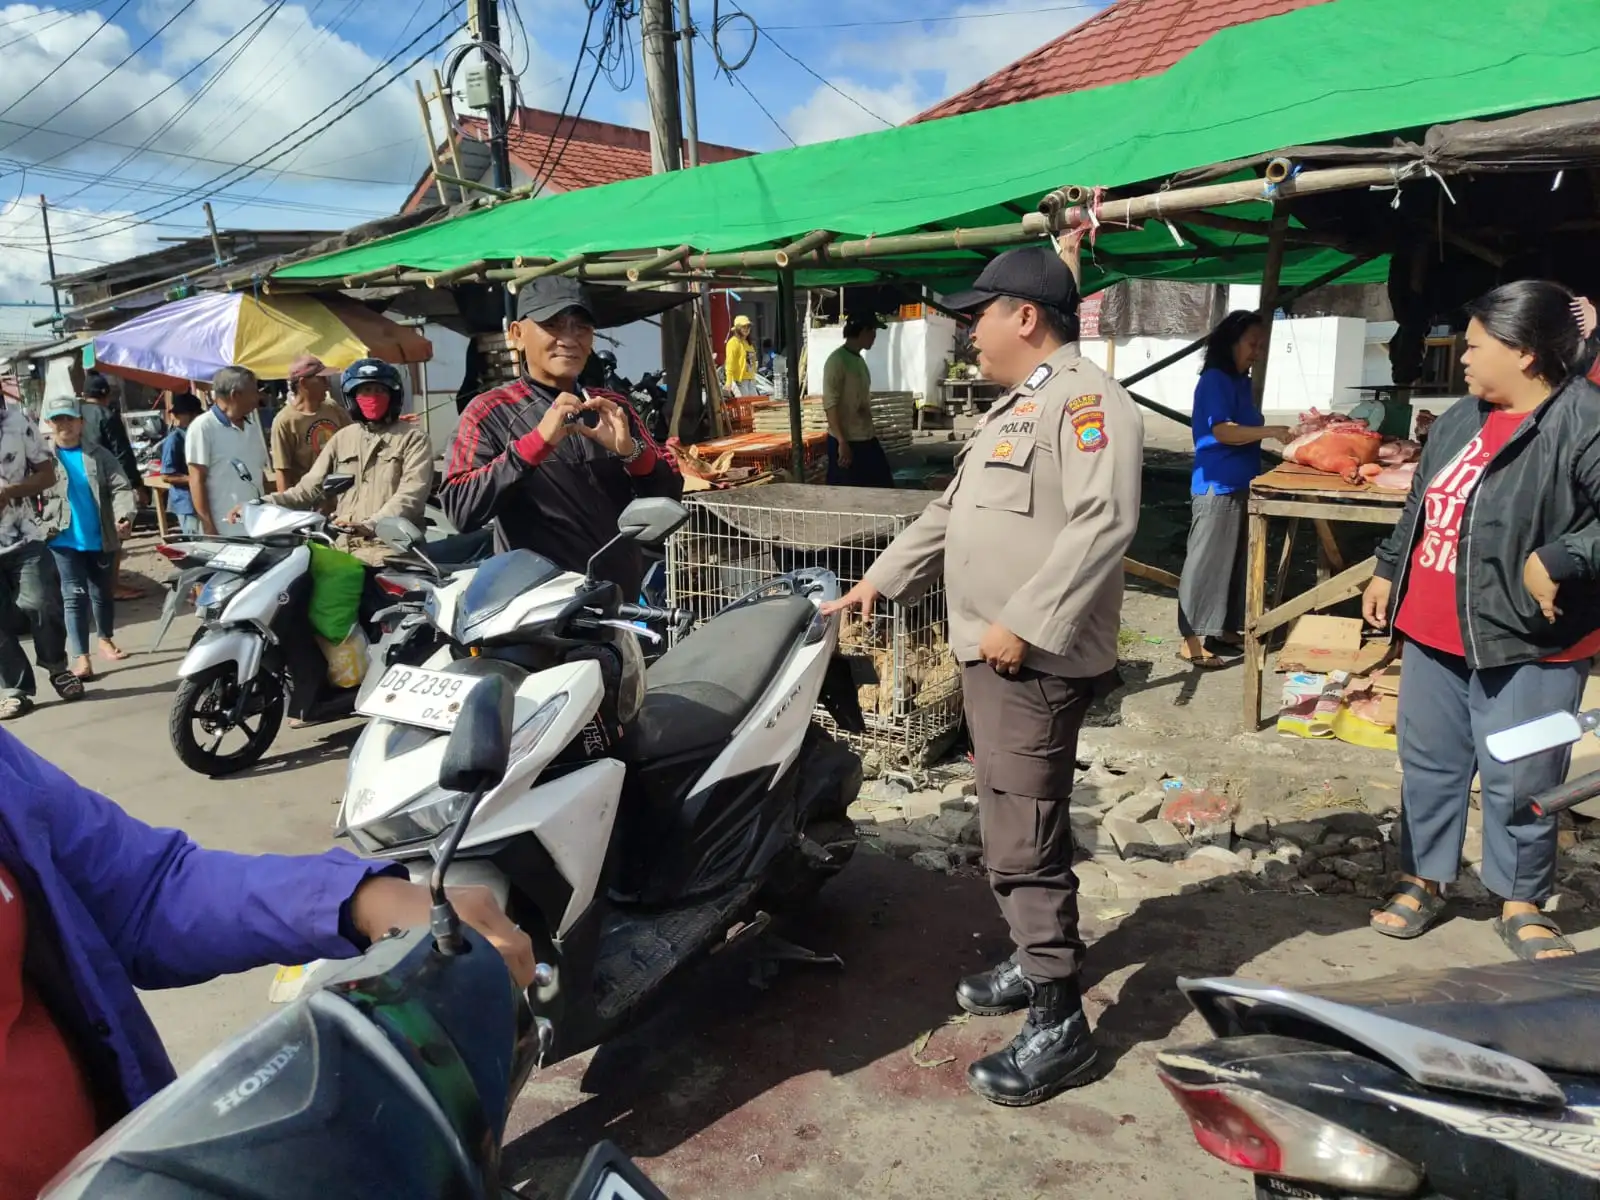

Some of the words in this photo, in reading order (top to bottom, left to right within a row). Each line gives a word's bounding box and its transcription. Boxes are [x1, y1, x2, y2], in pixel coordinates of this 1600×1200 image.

[998, 421, 1036, 435] POLRI
[380, 669, 413, 692] DB
[409, 674, 463, 699] 2399
[213, 1044, 301, 1117] HONDA
